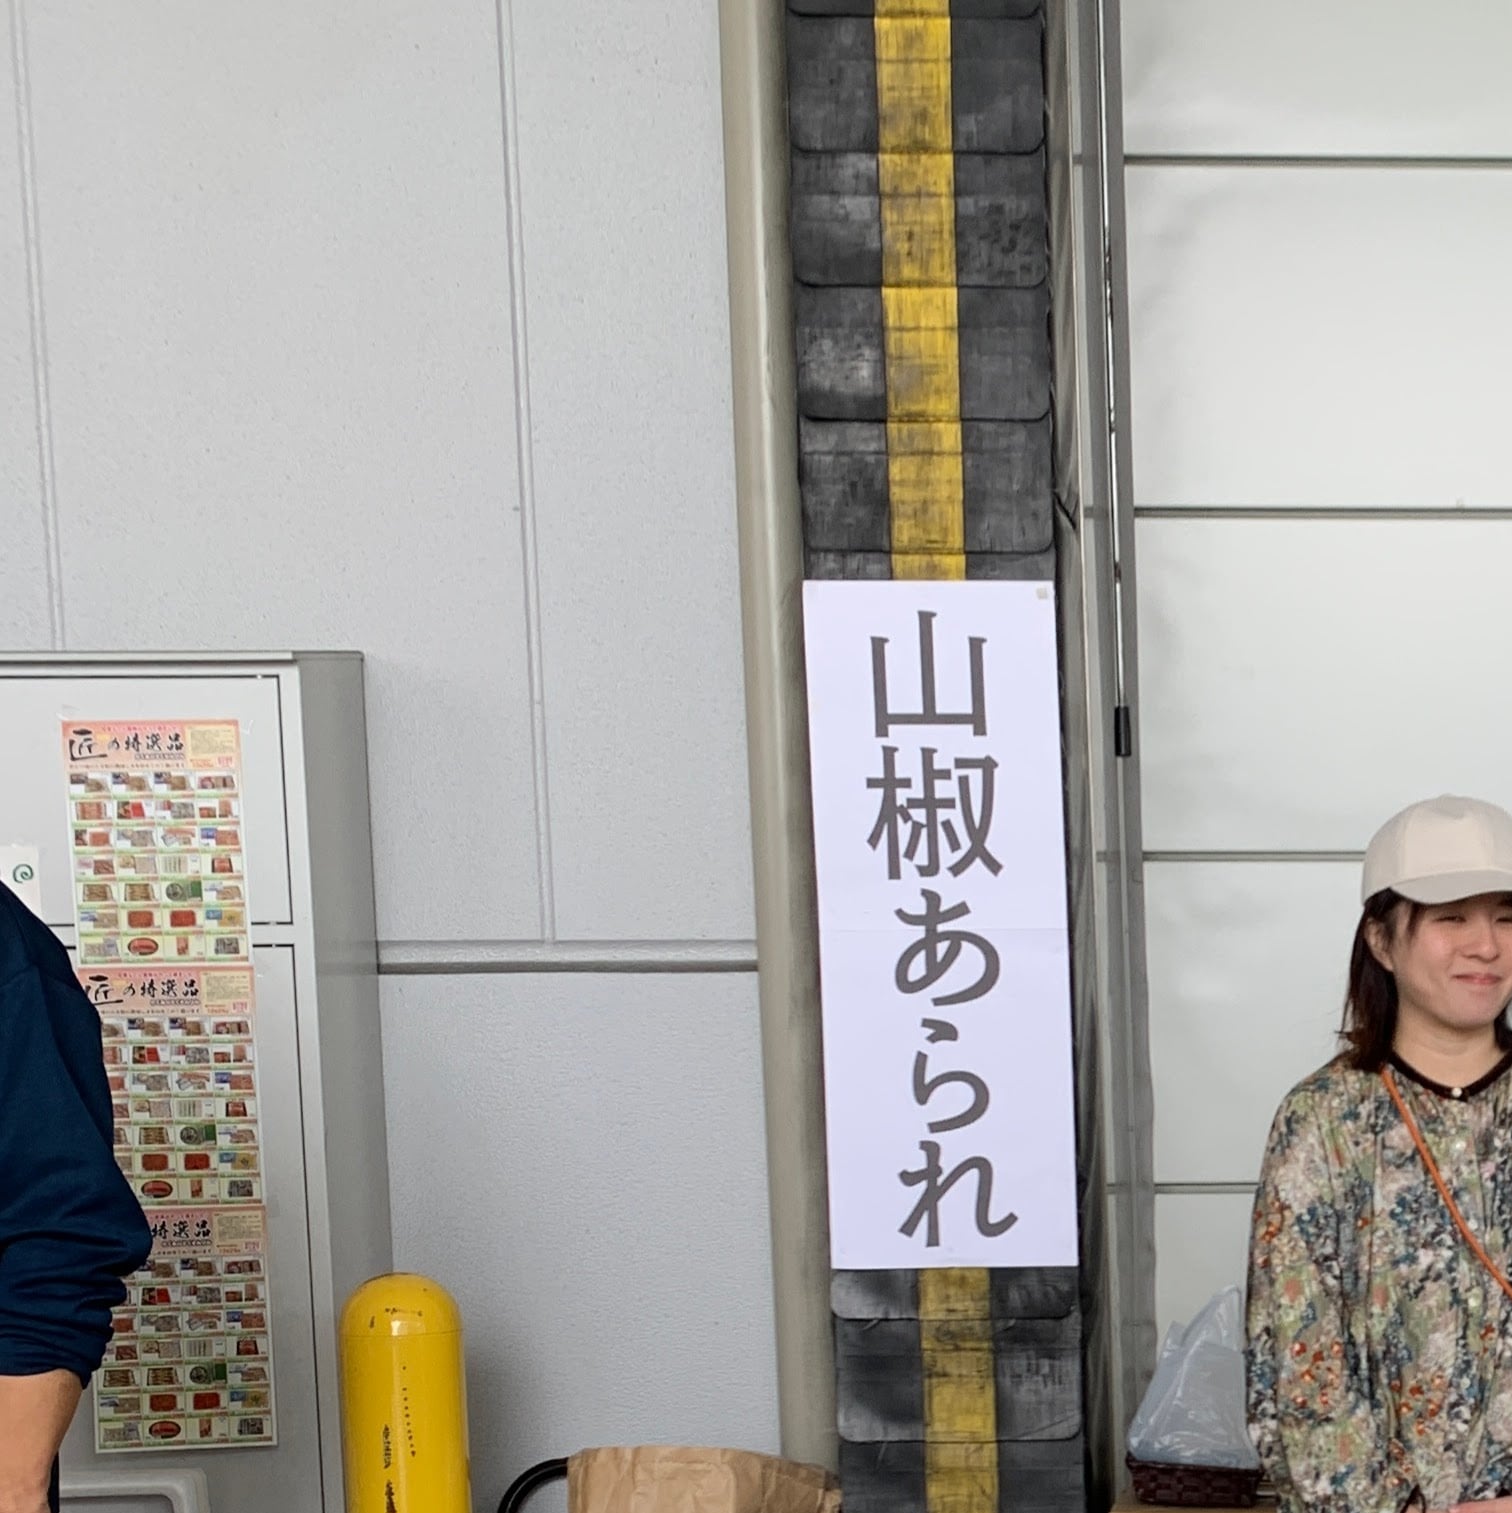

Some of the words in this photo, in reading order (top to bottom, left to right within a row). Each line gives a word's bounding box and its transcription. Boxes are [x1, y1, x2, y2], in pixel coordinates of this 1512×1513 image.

[866, 610, 1018, 1248] 山椒あられ
[151, 1220, 211, 1239] 特選品
